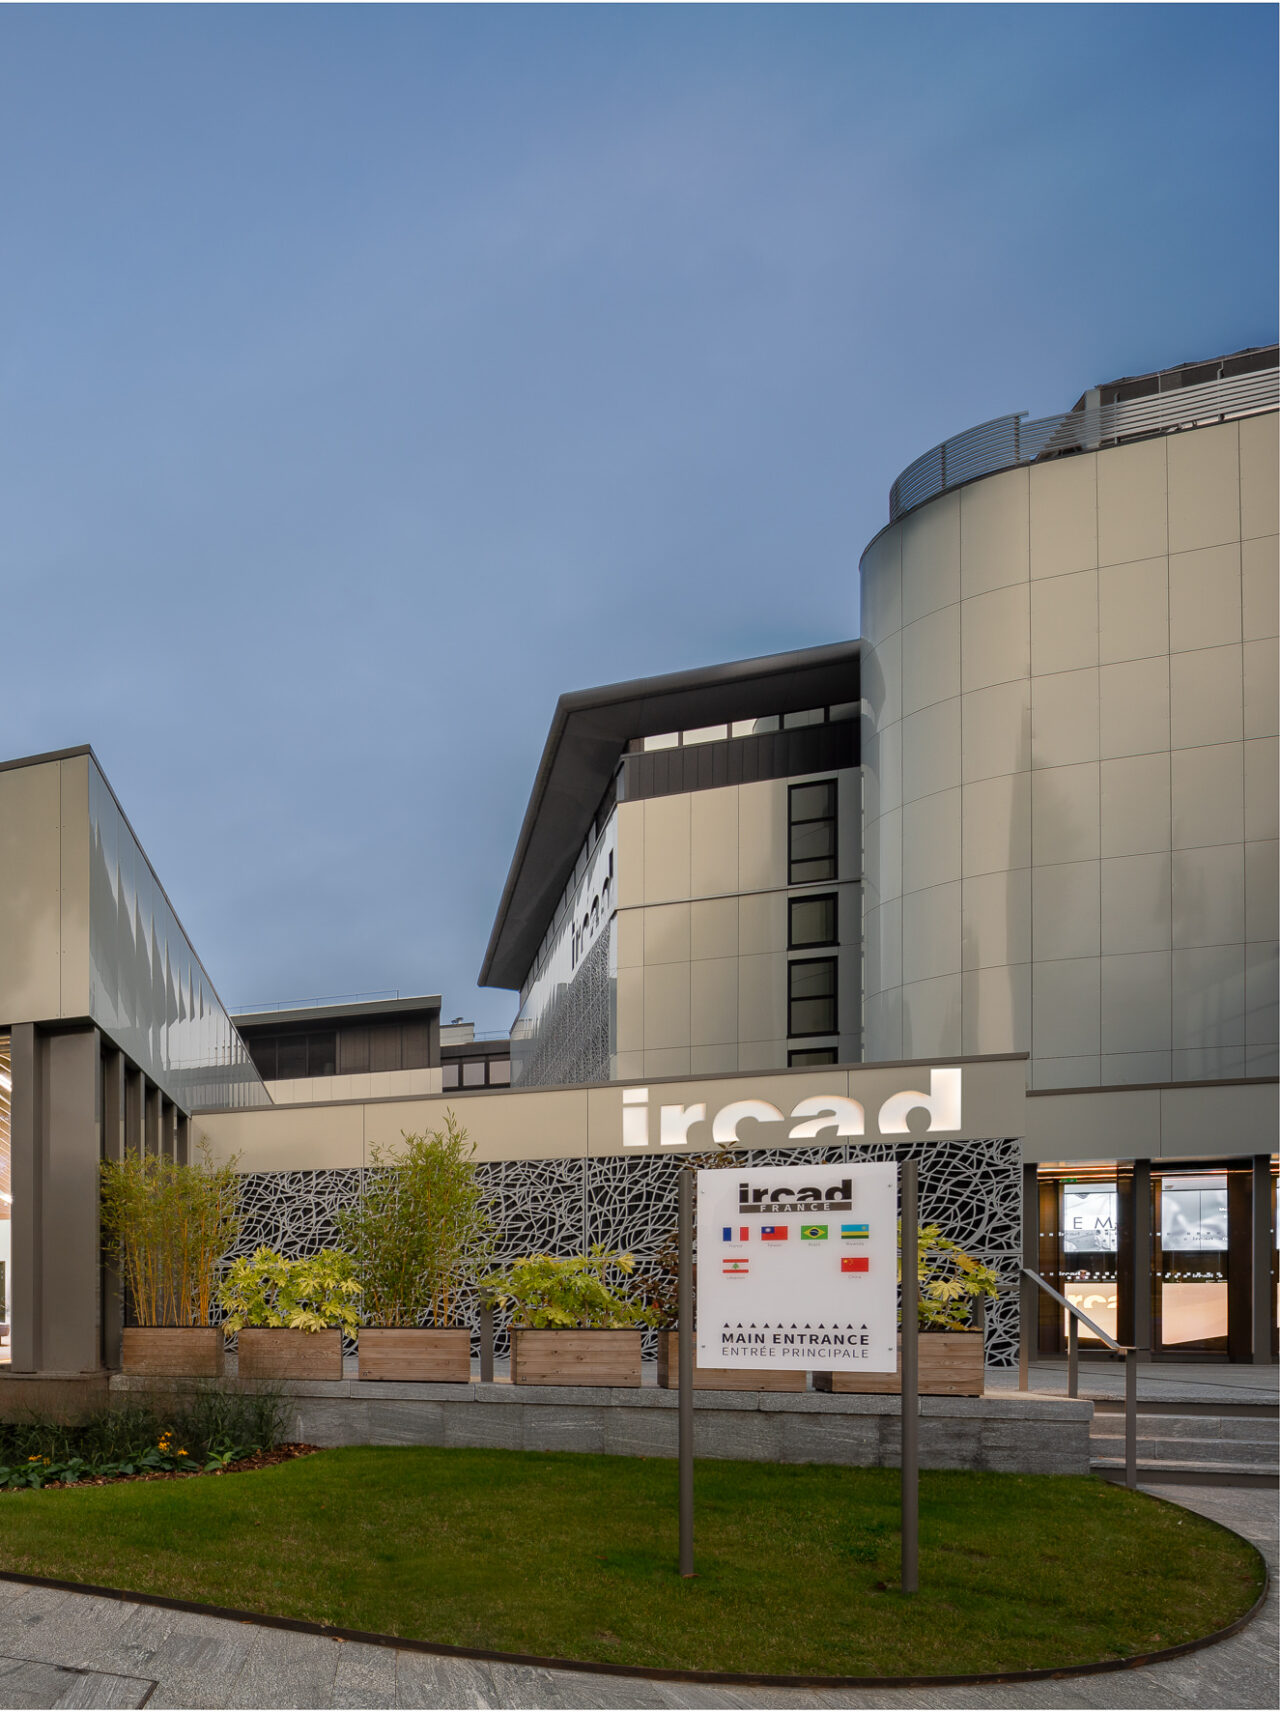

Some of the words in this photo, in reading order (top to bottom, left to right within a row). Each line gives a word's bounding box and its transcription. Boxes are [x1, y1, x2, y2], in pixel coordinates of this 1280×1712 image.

[622, 1068, 962, 1147] ircad
[739, 1179, 852, 1203] ircad
[760, 1202, 831, 1212] FRANCE
[722, 1333, 765, 1344] MAIN
[773, 1333, 869, 1345] ENTRANCE
[722, 1346, 776, 1357] ENTRÉE
[782, 1347, 869, 1359] PRINCIPALE
